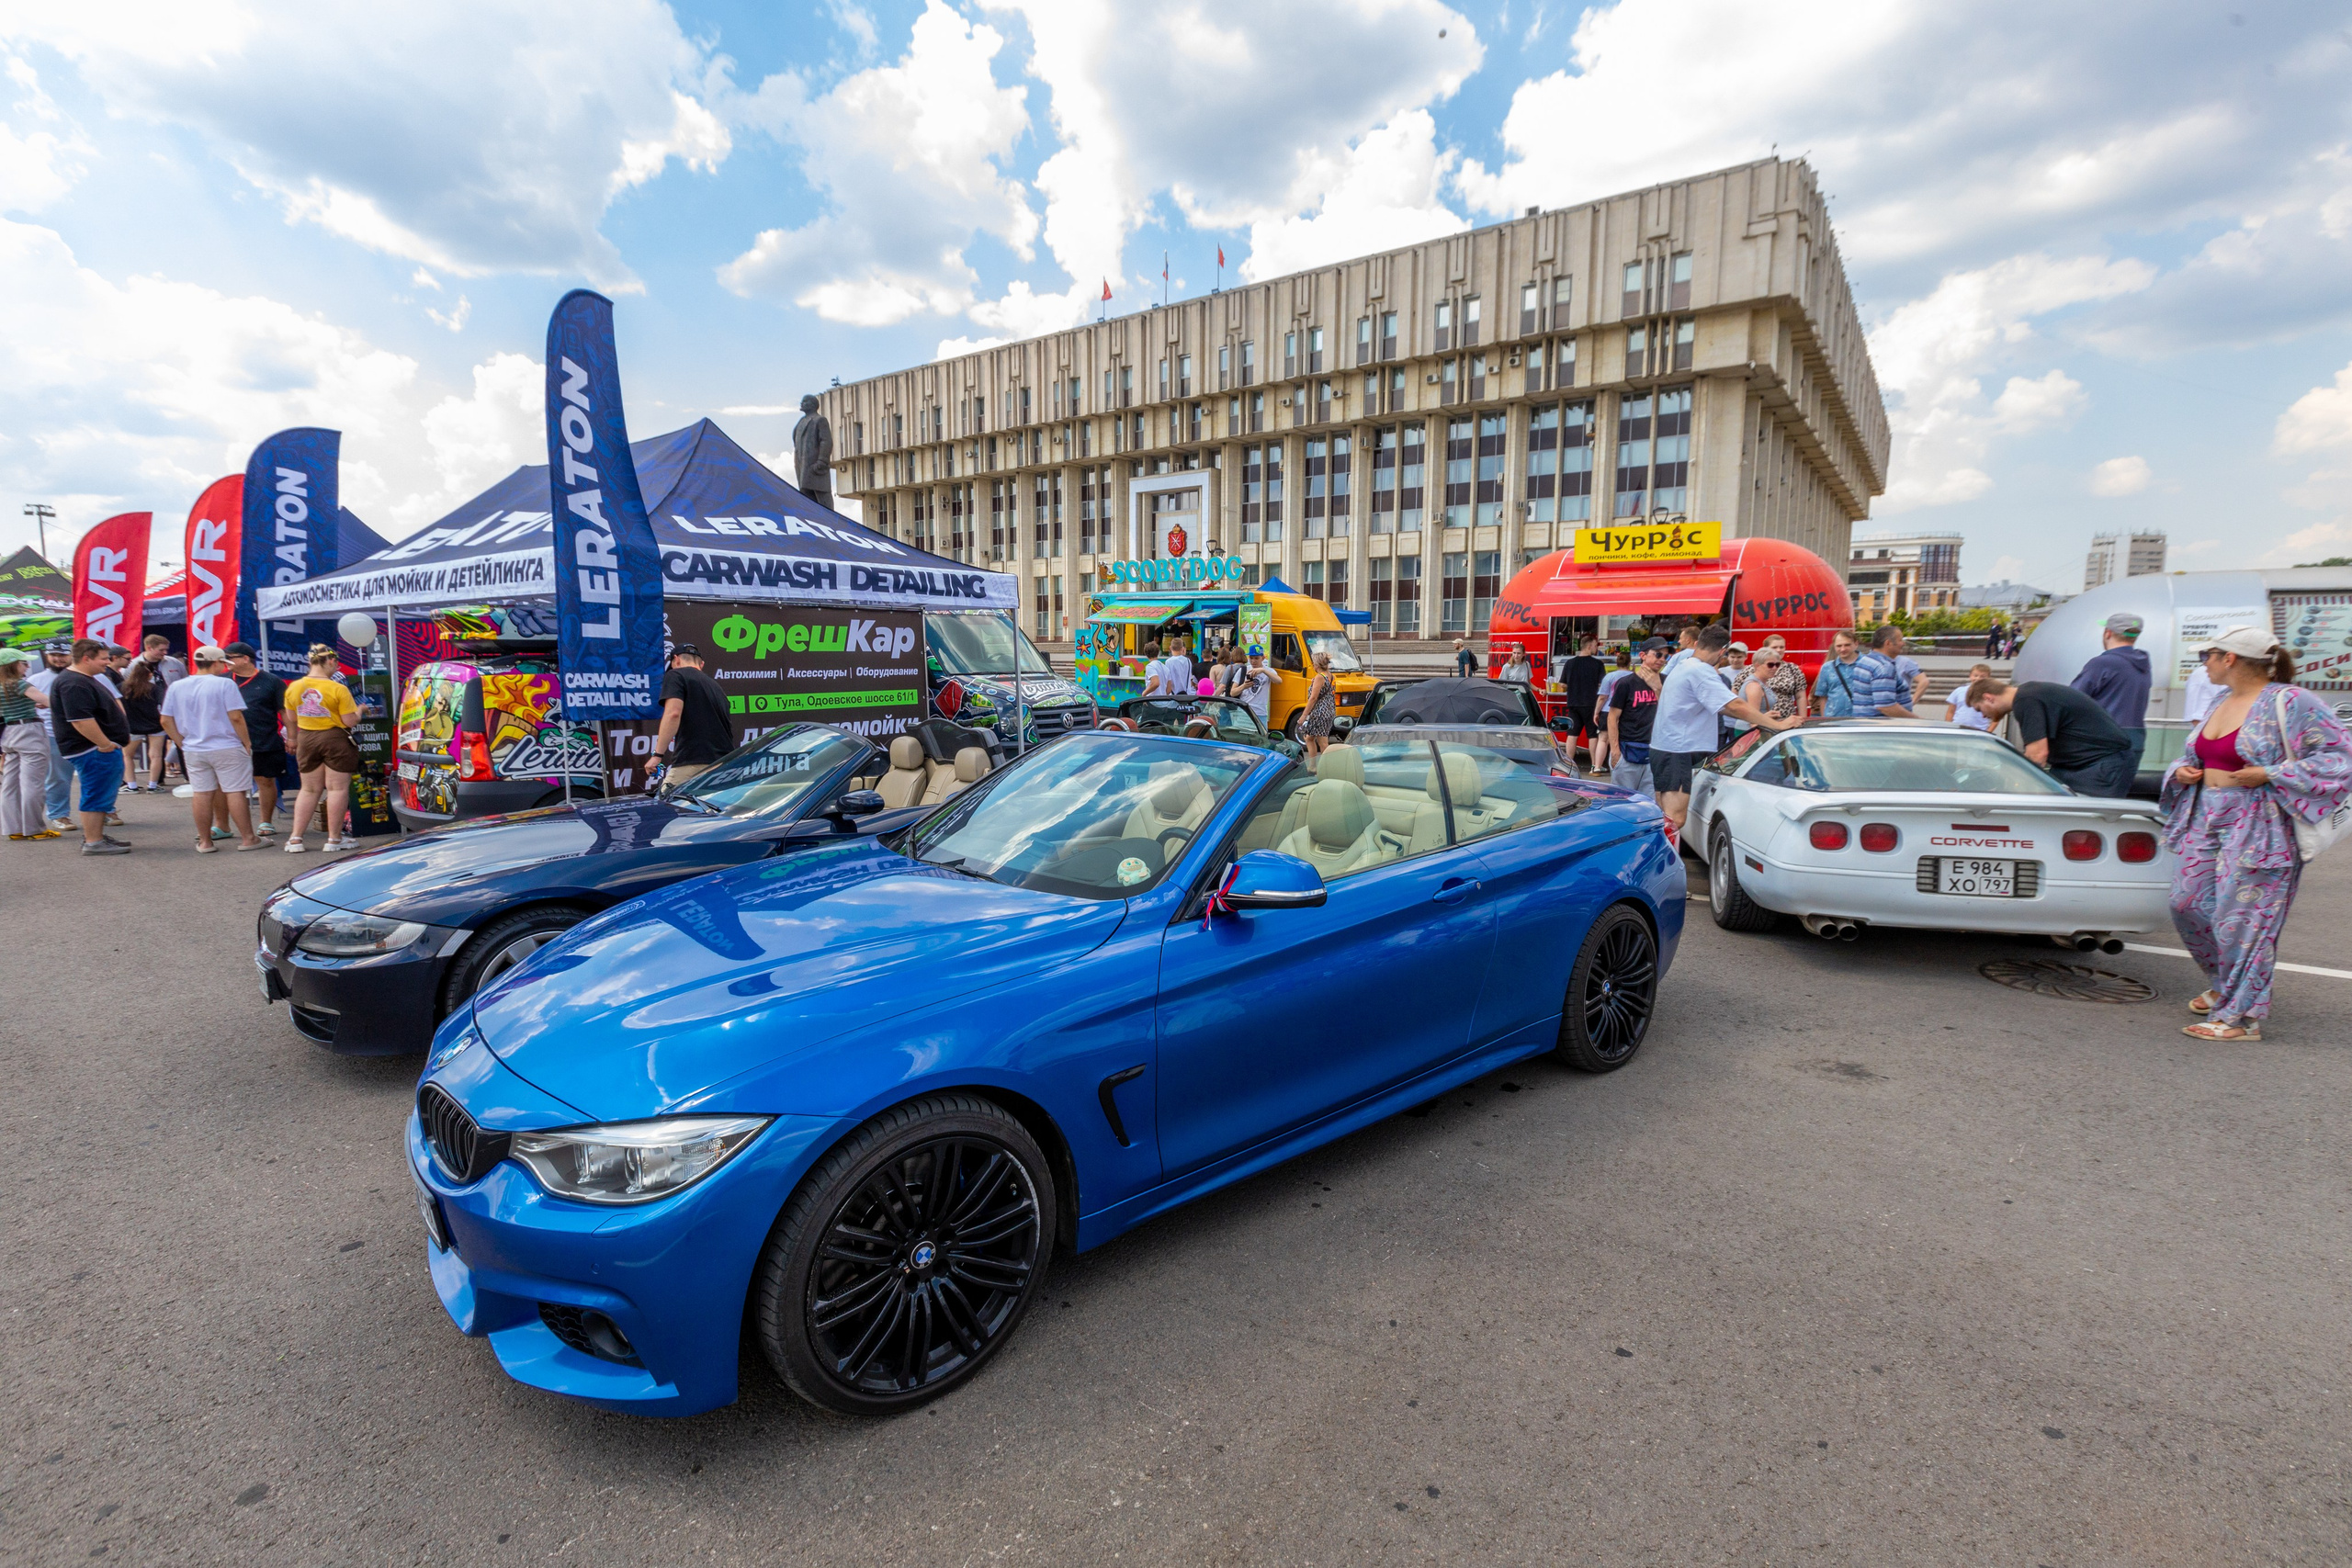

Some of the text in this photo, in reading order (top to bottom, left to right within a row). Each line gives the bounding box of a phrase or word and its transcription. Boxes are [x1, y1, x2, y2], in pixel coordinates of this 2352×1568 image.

[560, 355, 621, 639] LERATON
[672, 515, 908, 556] LERATON
[273, 467, 308, 634] LRATON
[1631, 552, 1657, 560] кофе,
[363, 578, 385, 601] ДЛЯ
[385, 569, 433, 594] МОЙКИ
[435, 570, 446, 591] И
[447, 557, 544, 592] ДЕТЕЙЛИНГА
[662, 551, 987, 599] CARWASH DETAILING
[1112, 555, 1244, 583] SCOBY DOG
[1736, 592, 1830, 624] ЧУРРОС
[712, 615, 915, 660] ФрешКар
[565, 672, 650, 690] CARWASH
[714, 666, 919, 681] Автохимия Аксессуары Оборудование
[566, 691, 652, 708] DETAILING
[775, 692, 915, 709] Тула, Одоевское шоссе 61/1
[502, 737, 603, 773] Lerato
[1930, 837, 2034, 849] CORVETTE
[1970, 862, 2004, 875] 984
[1984, 879, 2010, 890] 797
